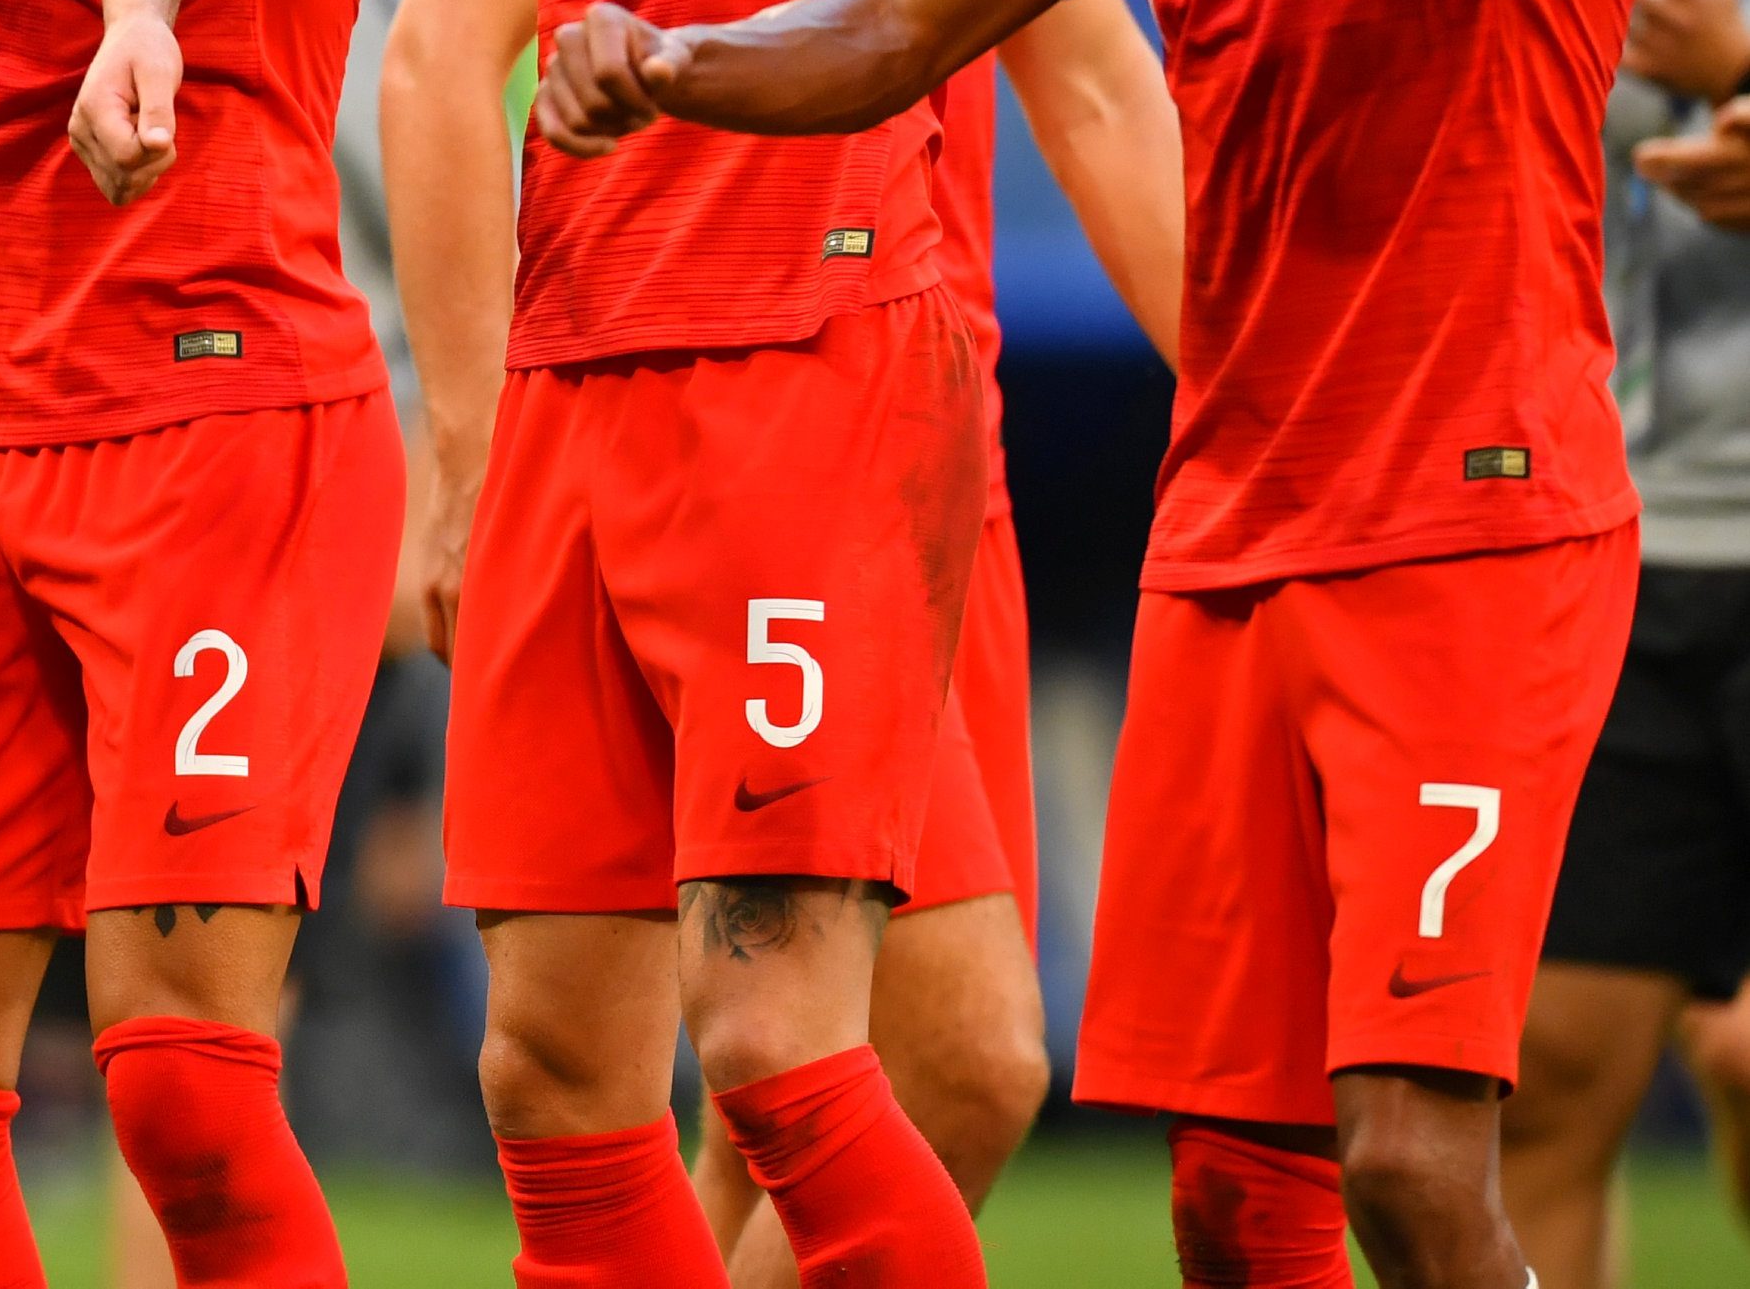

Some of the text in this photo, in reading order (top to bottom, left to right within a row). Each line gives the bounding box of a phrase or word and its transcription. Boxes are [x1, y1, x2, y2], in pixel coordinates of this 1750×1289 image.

[173, 628, 249, 778] 2
[744, 597, 826, 748] 5
[1418, 782, 1501, 939] 7
